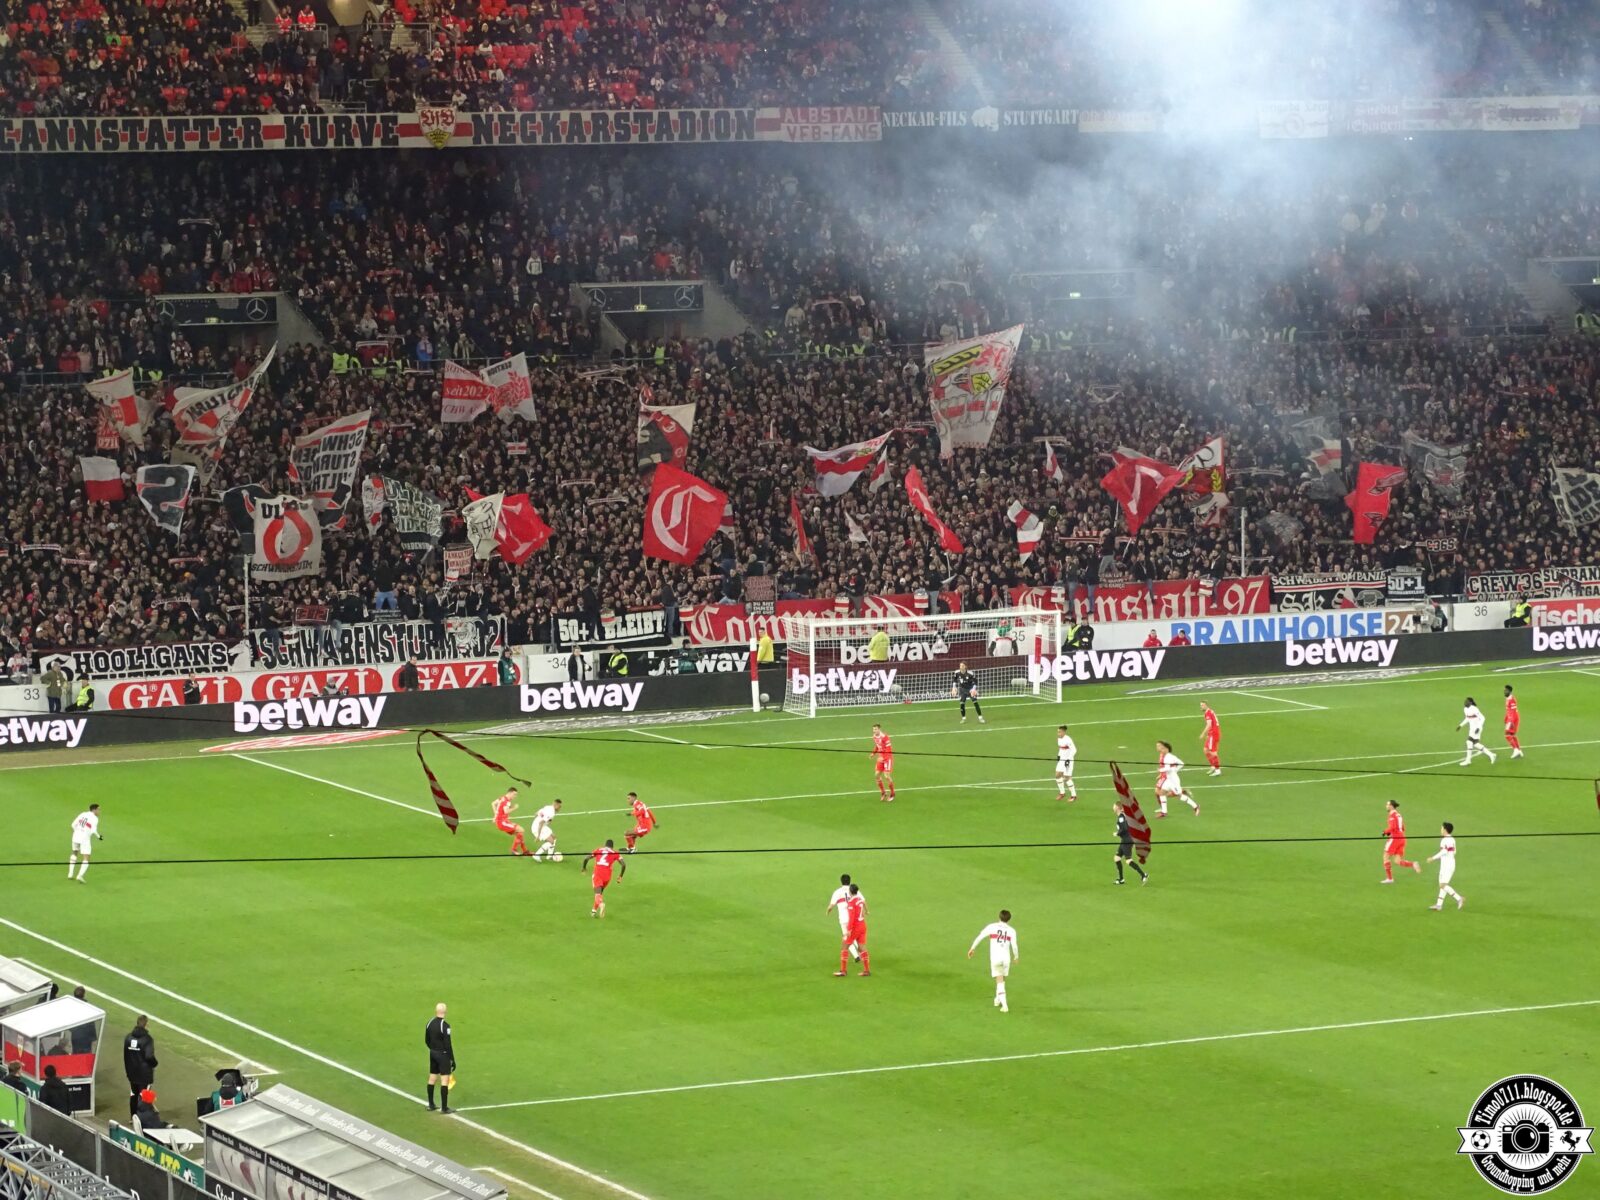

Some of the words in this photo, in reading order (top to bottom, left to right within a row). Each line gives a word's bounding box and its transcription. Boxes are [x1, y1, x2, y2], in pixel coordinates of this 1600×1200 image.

[471, 109, 756, 145] NECKARSTADION
[784, 106, 881, 124] ALBSTADT
[882, 111, 967, 128] NECKAR-FILS
[1003, 109, 1079, 126] STUTTGART
[284, 113, 399, 147] KURVE
[1387, 576, 1426, 591] 50+1
[1469, 576, 1520, 594] CREW
[1521, 573, 1542, 591] 36
[1222, 581, 1264, 616] 97
[1474, 605, 1488, 617] 36
[1012, 630, 1026, 642] 35
[1533, 626, 1600, 652] betw
[71, 643, 229, 675] HOOLIGANS
[552, 657, 567, 669] 34
[1285, 636, 1399, 667] betway
[1028, 649, 1166, 683] betway
[792, 667, 898, 694] betway
[24, 688, 40, 700] 33
[520, 681, 645, 712] betway
[234, 695, 387, 732] betway
